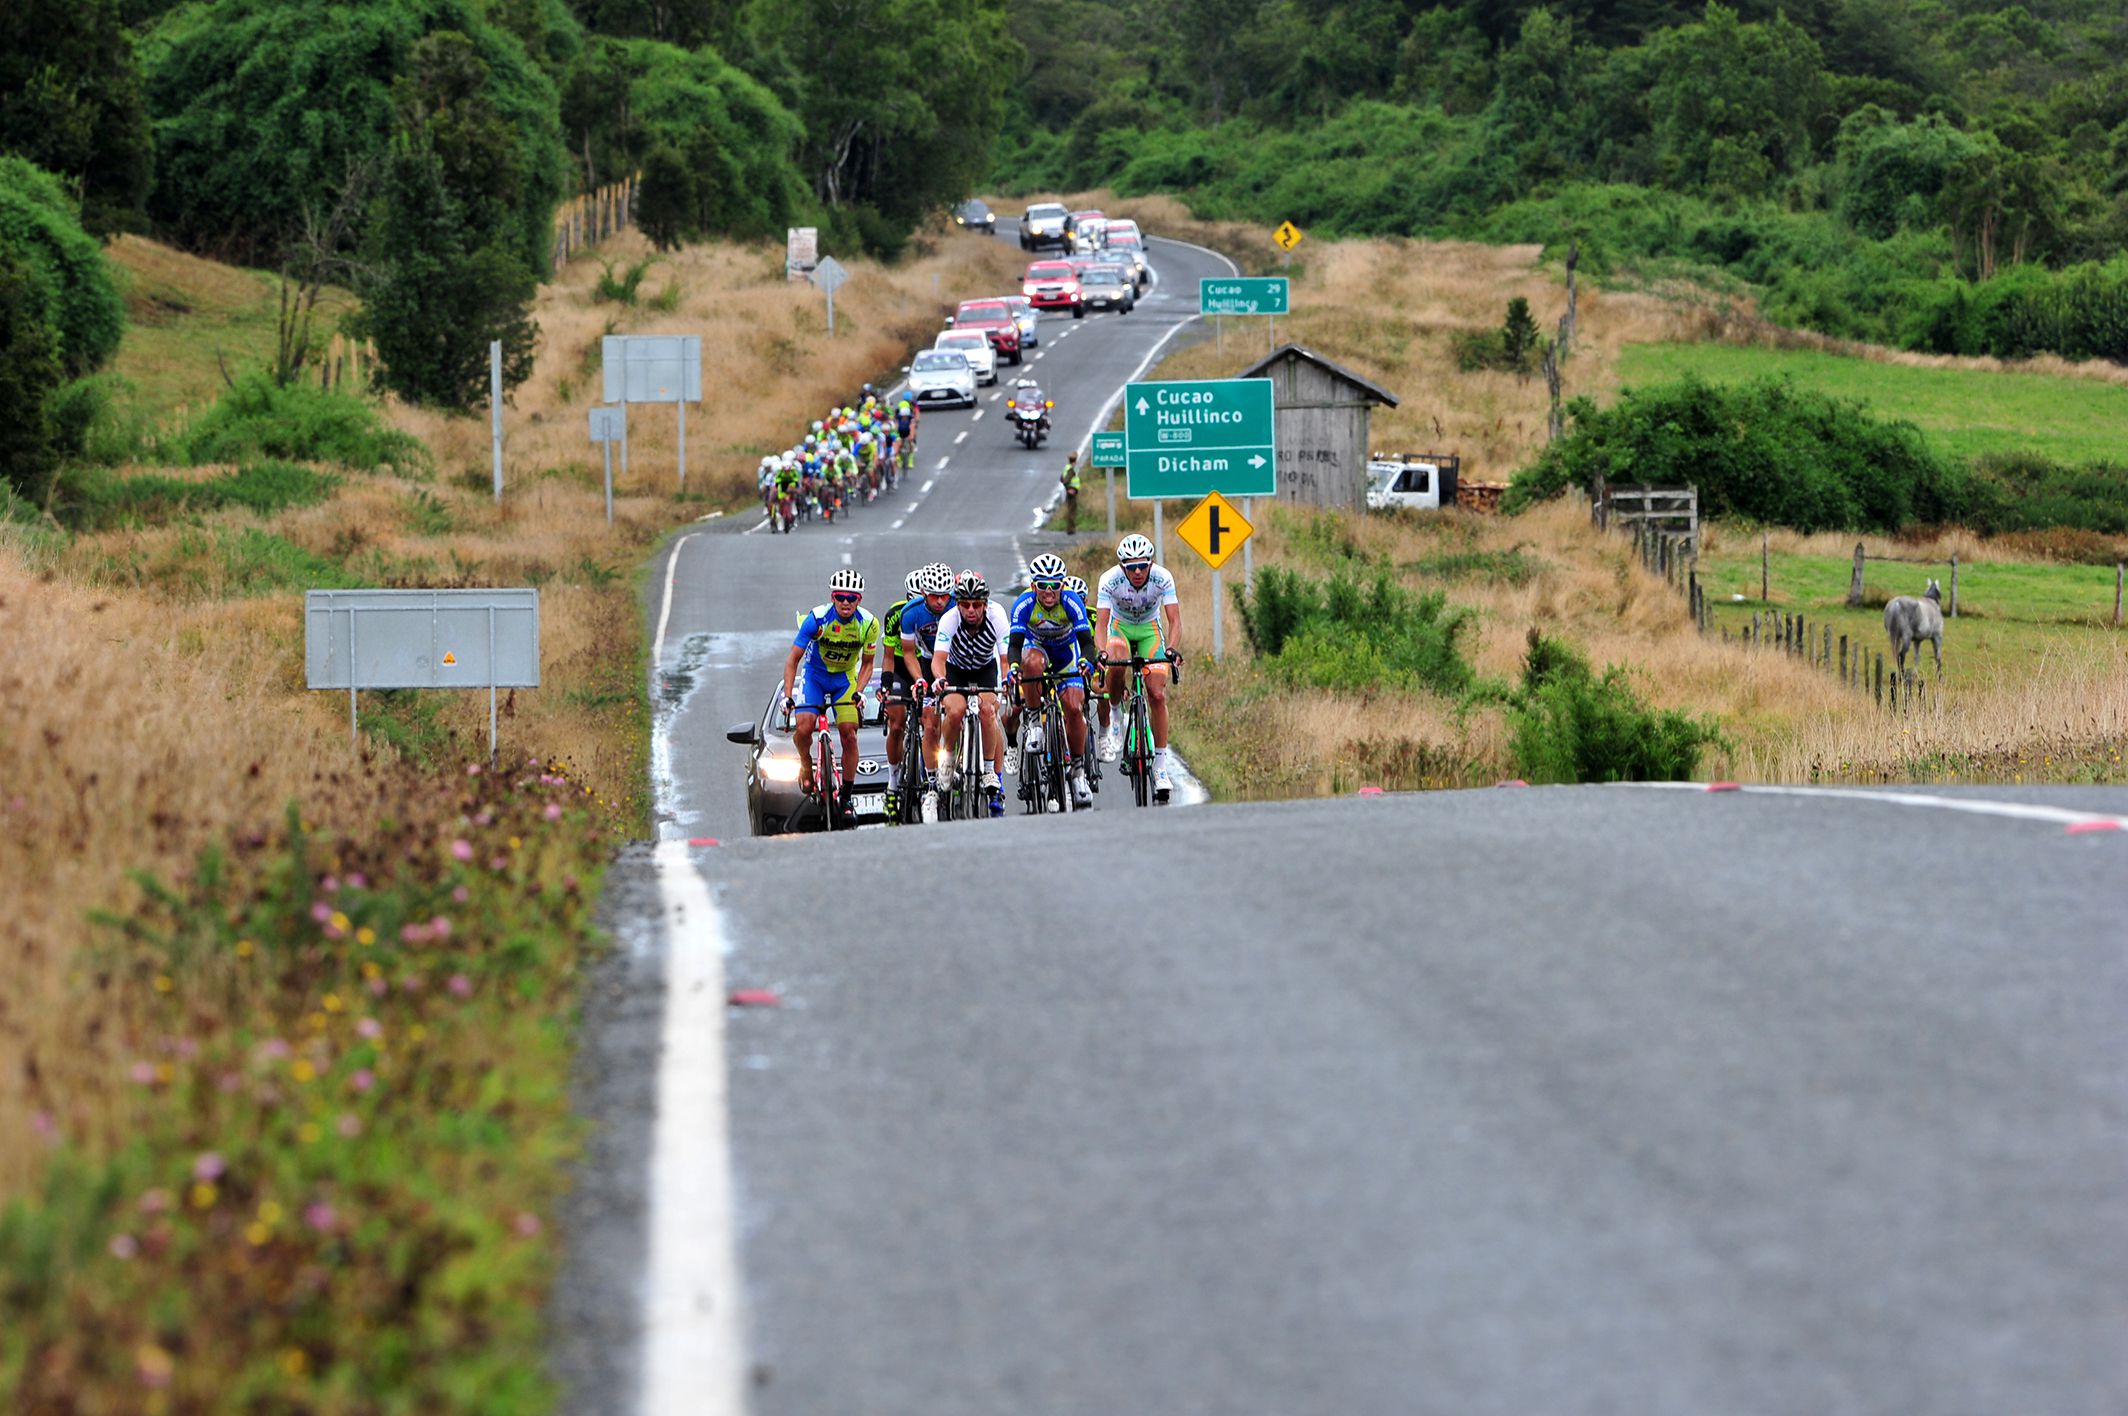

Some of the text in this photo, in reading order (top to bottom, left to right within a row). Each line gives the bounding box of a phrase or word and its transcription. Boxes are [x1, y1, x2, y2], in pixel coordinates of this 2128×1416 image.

[1207, 283, 1281, 295] Cucao 29
[1275, 297, 1281, 308] 7
[1157, 389, 1213, 405] Cucao
[1157, 408, 1243, 425] Huillinco
[1158, 455, 1229, 473] Dicham
